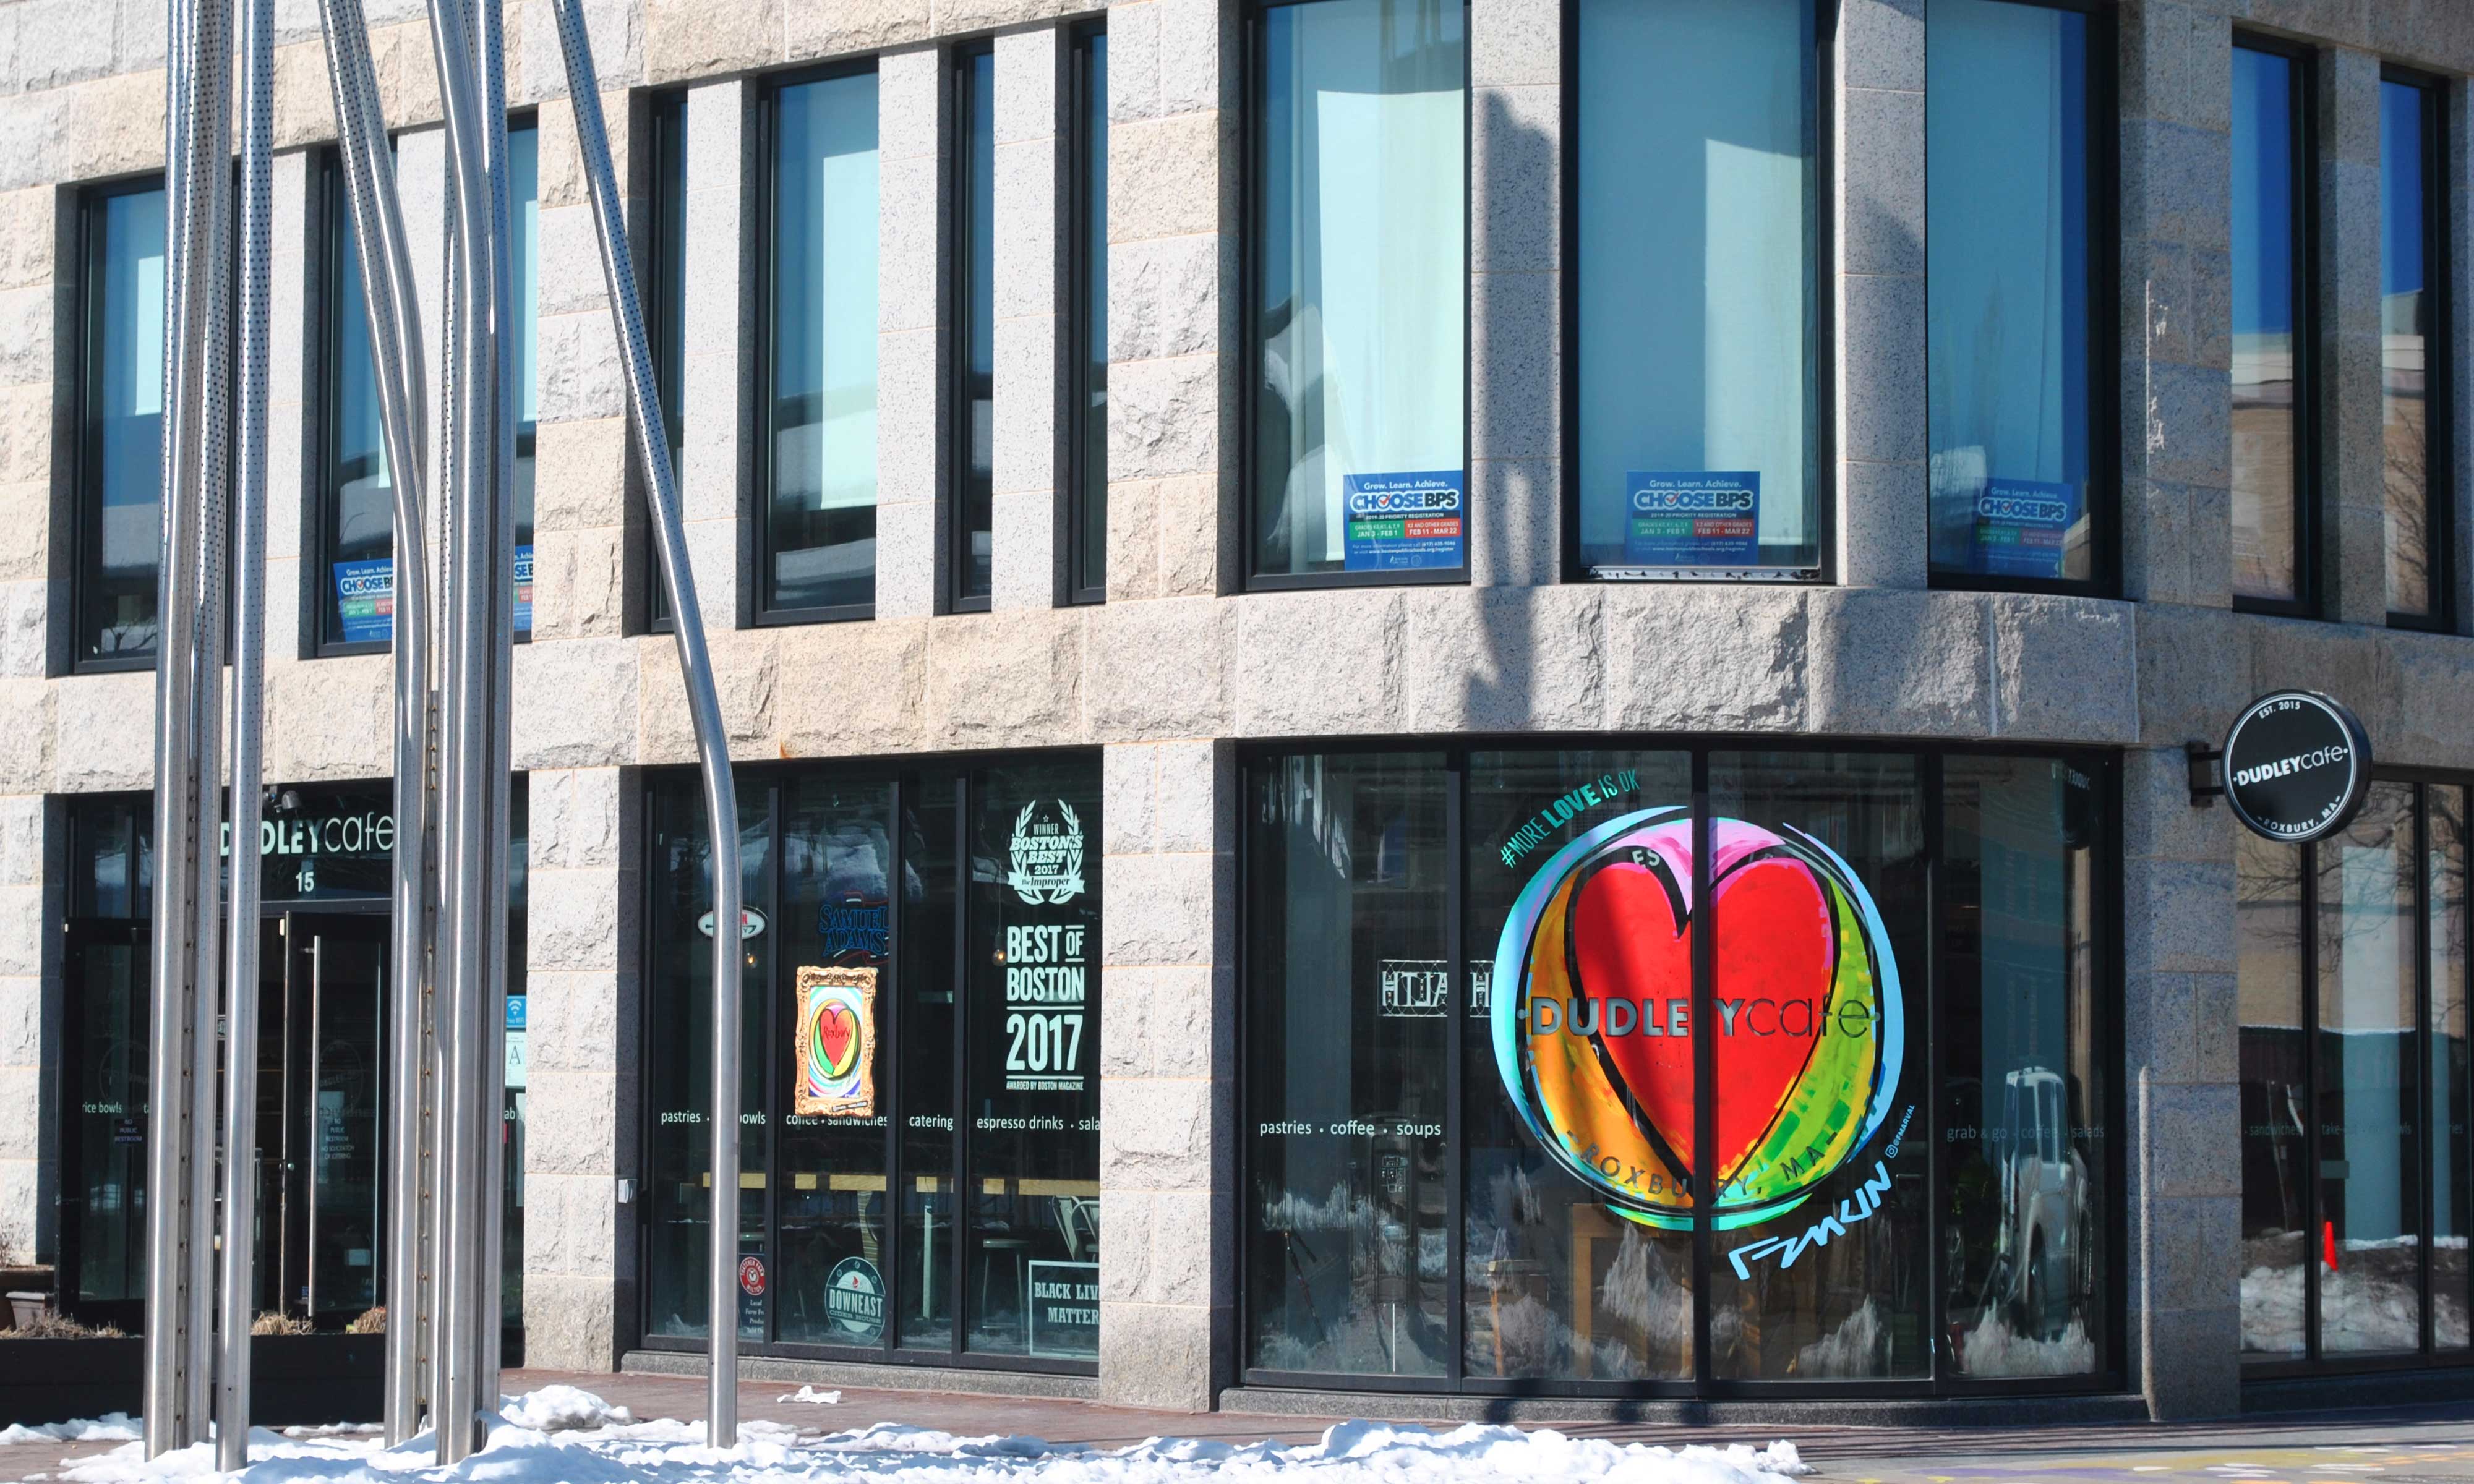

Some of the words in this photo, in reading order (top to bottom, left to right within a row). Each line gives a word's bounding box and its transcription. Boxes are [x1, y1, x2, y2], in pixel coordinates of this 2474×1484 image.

[1415, 480, 1447, 488] Achieve.
[1650, 480, 1675, 488] Grow.
[1705, 480, 1742, 488] Achieve.
[1991, 487, 2010, 495] Grow.
[2258, 706, 2276, 719] EST.
[2279, 701, 2301, 710] 2015
[1500, 816, 1551, 868] #MORE
[1541, 783, 1601, 829] LOVE
[1598, 774, 1618, 799] IS
[1618, 769, 1640, 792] OK
[1034, 823, 1059, 835] WINNER
[1009, 835, 1084, 851] BOSTON'S
[1027, 850, 1068, 864] BEST
[1034, 865, 1059, 875] 2017
[296, 871, 314, 892] 15
[1031, 877, 1070, 888] Improper
[818, 904, 890, 933] SAMUEL
[821, 928, 886, 957] ADAMS
[1007, 925, 1062, 963] BEST
[1066, 931, 1084, 956] OF
[1006, 966, 1085, 1002] BOSTON
[1006, 1013, 1083, 1072] 2017
[509, 1045, 520, 1064] A
[1006, 1081, 1030, 1090] AWARDED
[1030, 1081, 1037, 1090] BY
[1038, 1081, 1058, 1090] BOSTON
[1058, 1081, 1084, 1091] MAGAZINE
[98, 1101, 122, 1114] bowls
[661, 1110, 701, 1125] pastries
[740, 1111, 766, 1125] owls
[909, 1114, 953, 1132] catering
[977, 1117, 1025, 1132] espresso
[1029, 1115, 1064, 1130] drinks
[1079, 1115, 1100, 1131] sala
[1260, 1120, 1311, 1136] pastries
[1330, 1120, 1375, 1135] coffee
[1397, 1124, 1441, 1138] soups
[1946, 1124, 1976, 1143] grab
[1992, 1128, 2006, 1143] go
[2073, 1124, 2104, 1138] salads
[1780, 1145, 1825, 1182] MA
[1034, 1282, 1071, 1299] BLACK
[1076, 1284, 1099, 1300] LIV
[829, 1289, 883, 1318] DOWNEAST
[829, 1310, 853, 1319] CIDER
[855, 1315, 881, 1323] HOUSE
